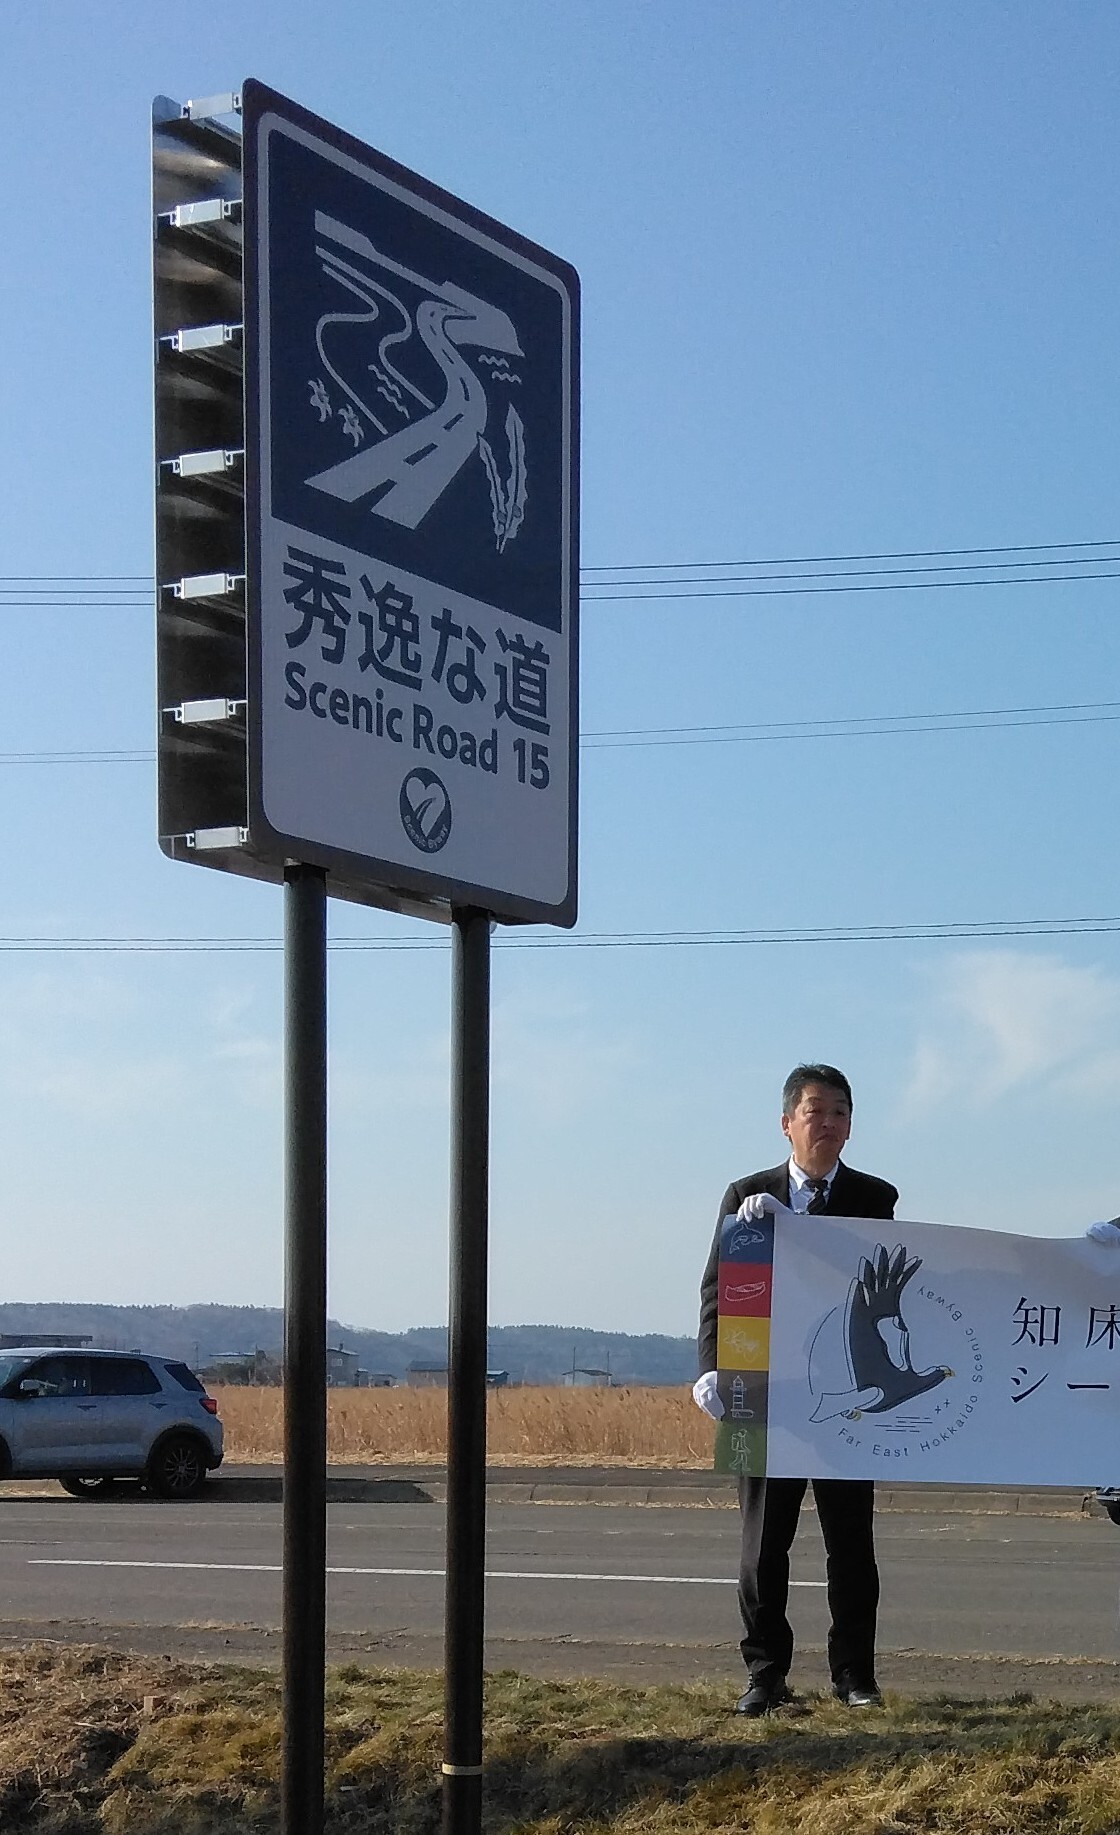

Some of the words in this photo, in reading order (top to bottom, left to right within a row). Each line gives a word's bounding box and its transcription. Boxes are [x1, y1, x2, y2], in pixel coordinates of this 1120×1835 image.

[282, 545, 551, 736] 秀逸な道
[284, 661, 403, 743] Scenic
[412, 703, 498, 775] Road
[513, 737, 550, 790] 15
[917, 1286, 962, 1321] Byway
[965, 1328, 983, 1383] Scenic
[838, 1427, 861, 1447] Far
[872, 1444, 909, 1457] East
[919, 1395, 978, 1452] Hokkaido
